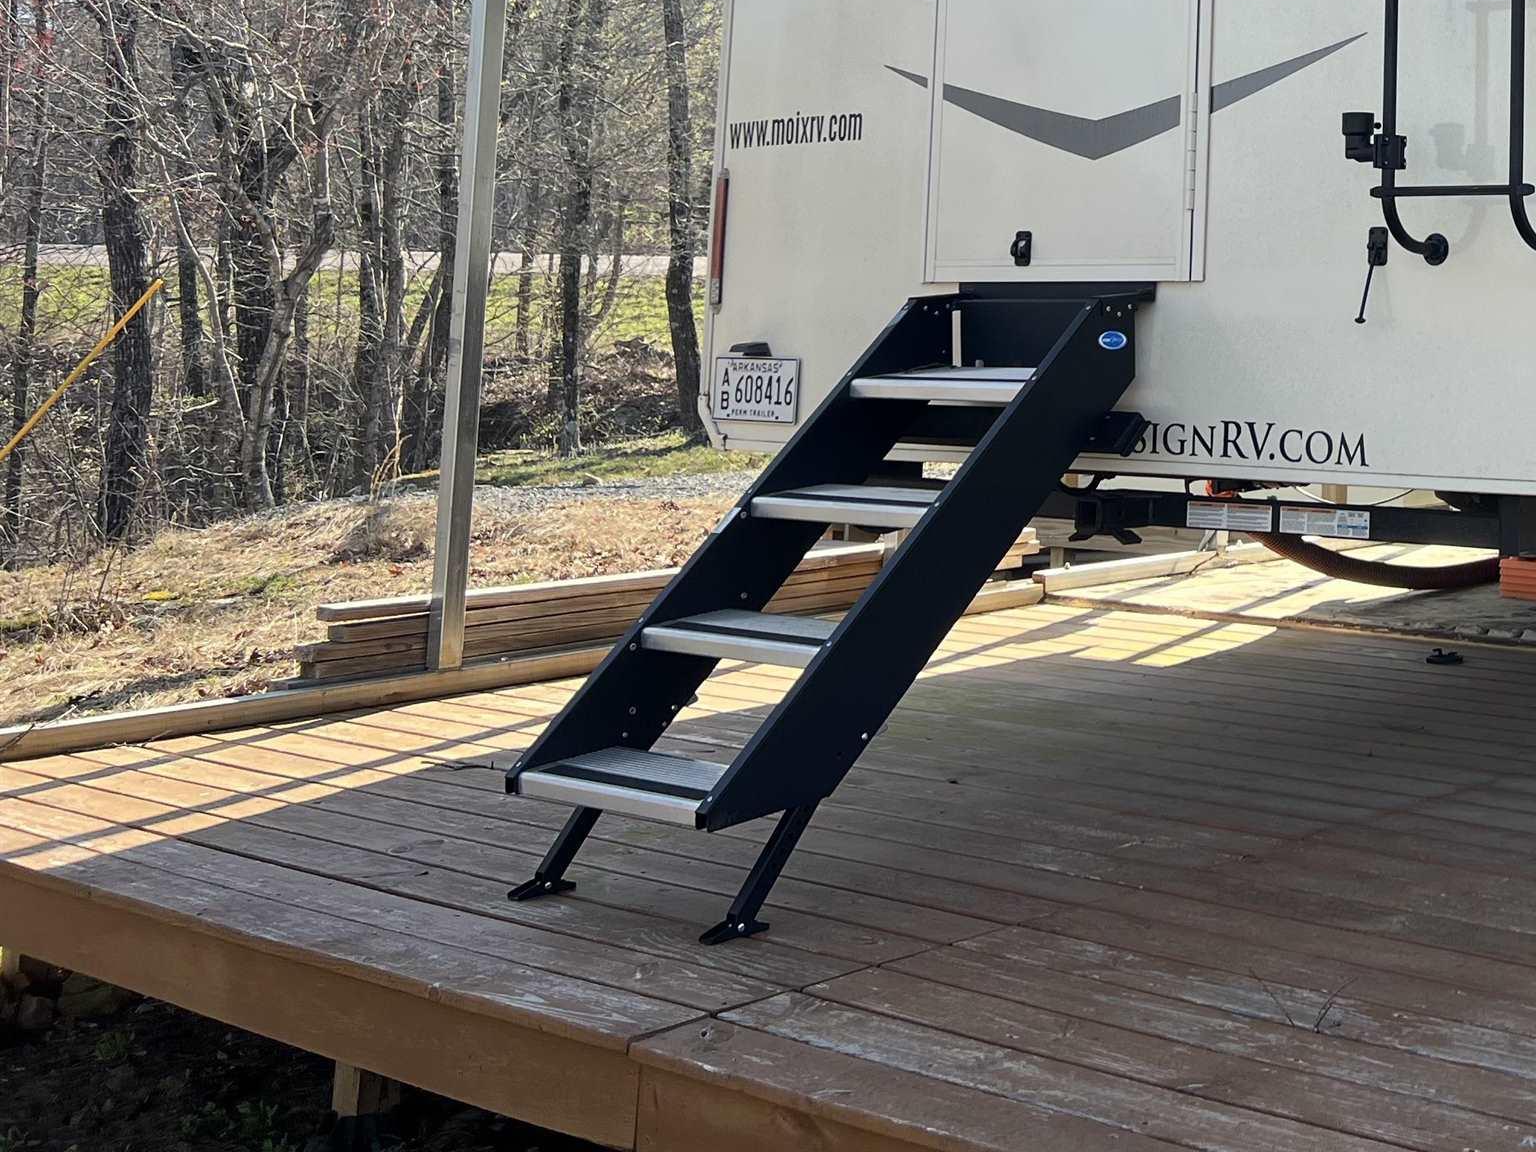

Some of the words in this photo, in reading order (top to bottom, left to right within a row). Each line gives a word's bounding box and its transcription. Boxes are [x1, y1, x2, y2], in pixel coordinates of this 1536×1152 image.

[729, 111, 863, 149] www.moixrv.com
[732, 361, 781, 373] ARKANSAS
[735, 375, 794, 406] 608416
